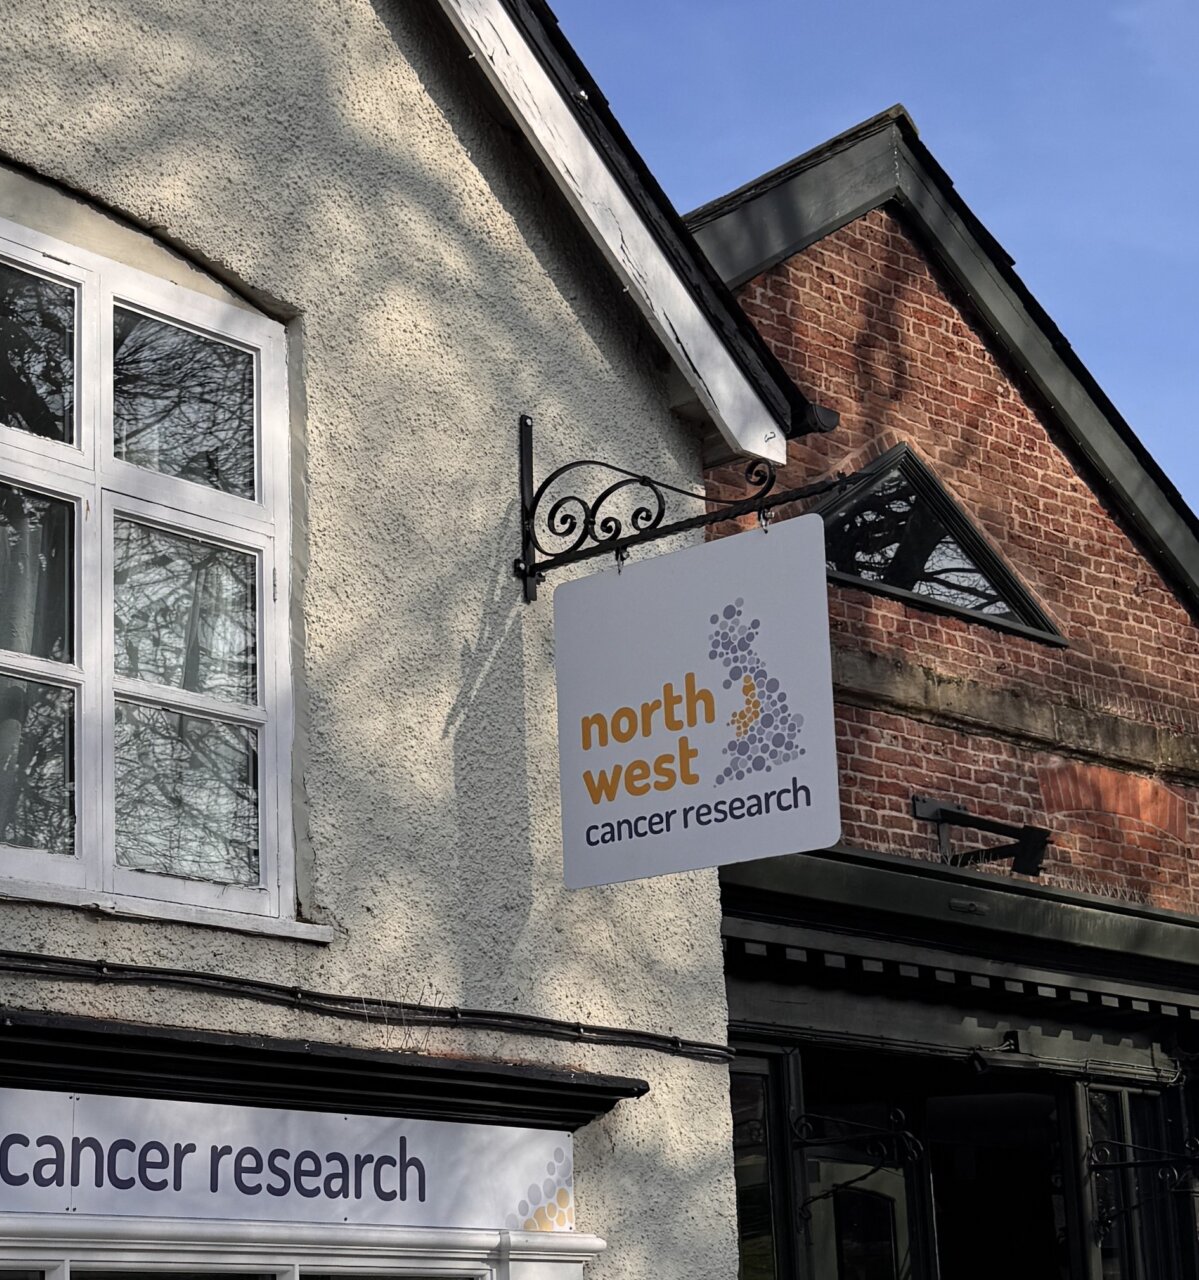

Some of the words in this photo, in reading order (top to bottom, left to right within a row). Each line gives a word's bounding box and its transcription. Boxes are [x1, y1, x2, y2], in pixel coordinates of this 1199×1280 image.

[581, 671, 715, 750] north
[582, 736, 700, 805] west
[585, 808, 677, 847] cancer
[682, 776, 812, 829] research
[209, 1135, 426, 1203] research
